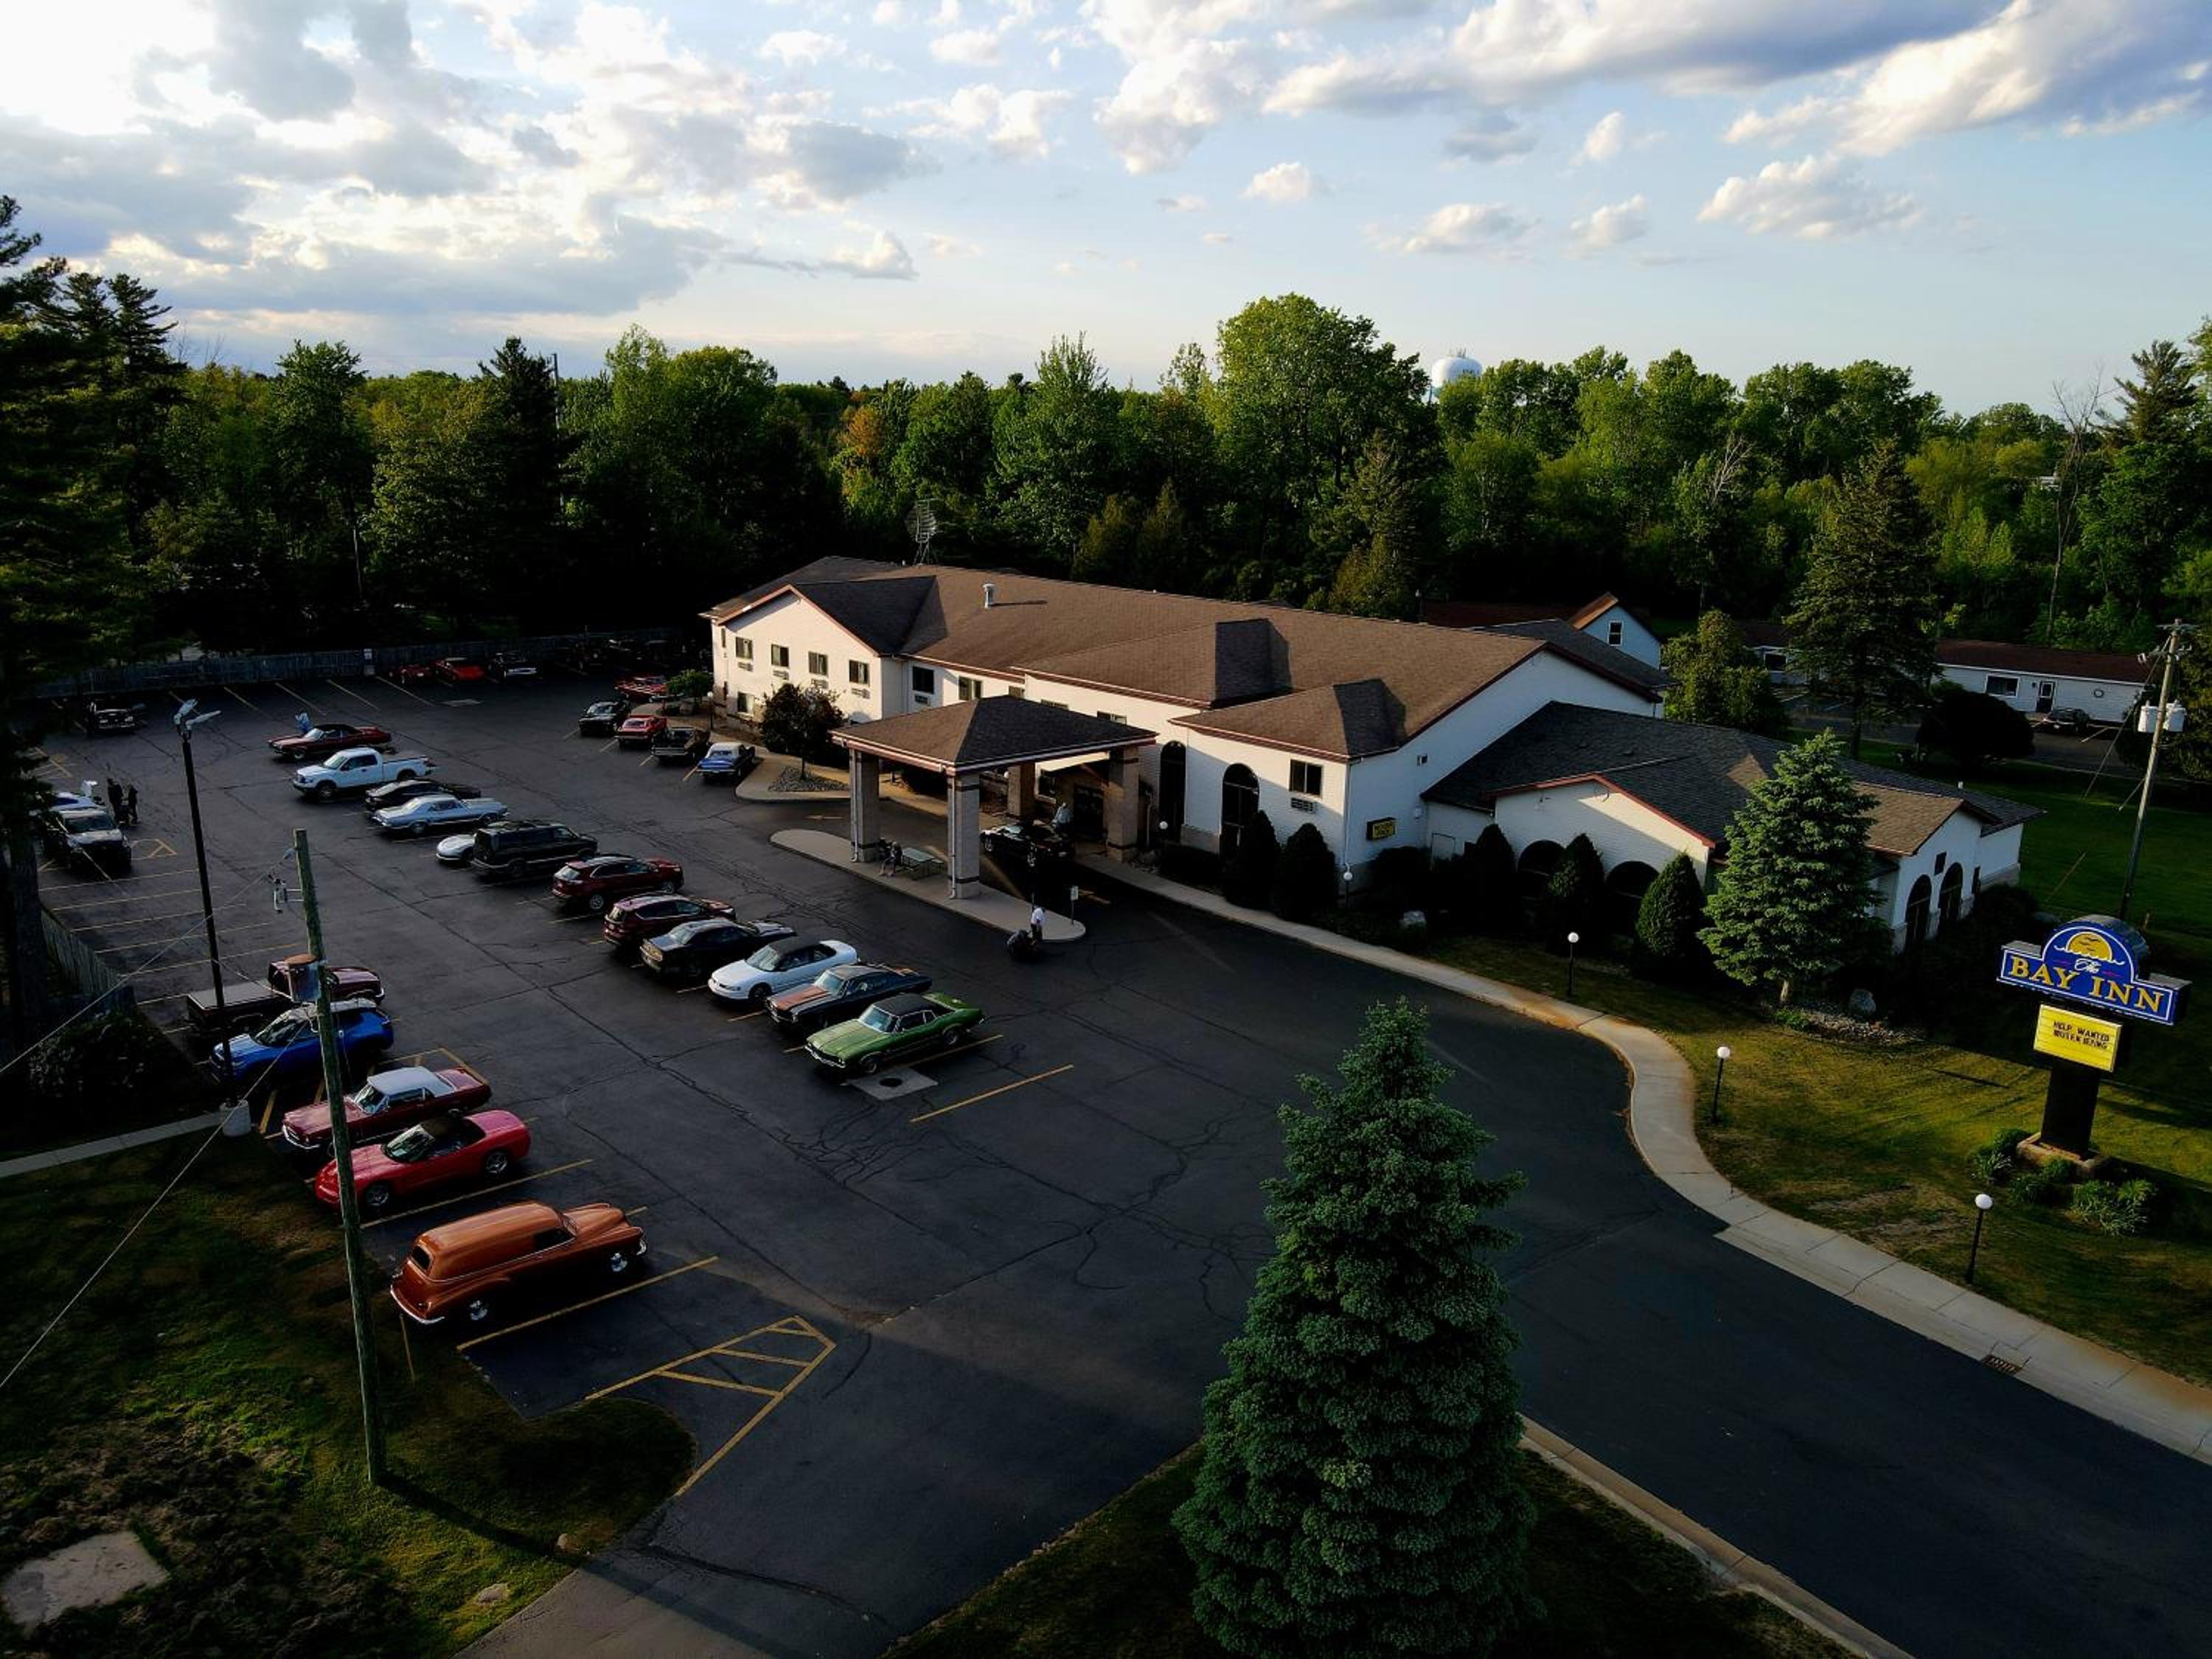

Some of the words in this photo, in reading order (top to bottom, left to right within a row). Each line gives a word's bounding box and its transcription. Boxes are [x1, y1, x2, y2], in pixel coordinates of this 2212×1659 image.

[2075, 959, 2101, 973] The
[2010, 956, 2079, 990] BAY
[2090, 976, 2163, 1012] INN
[2053, 1020, 2073, 1032] HELP
[2076, 1027, 2110, 1042] WANTED
